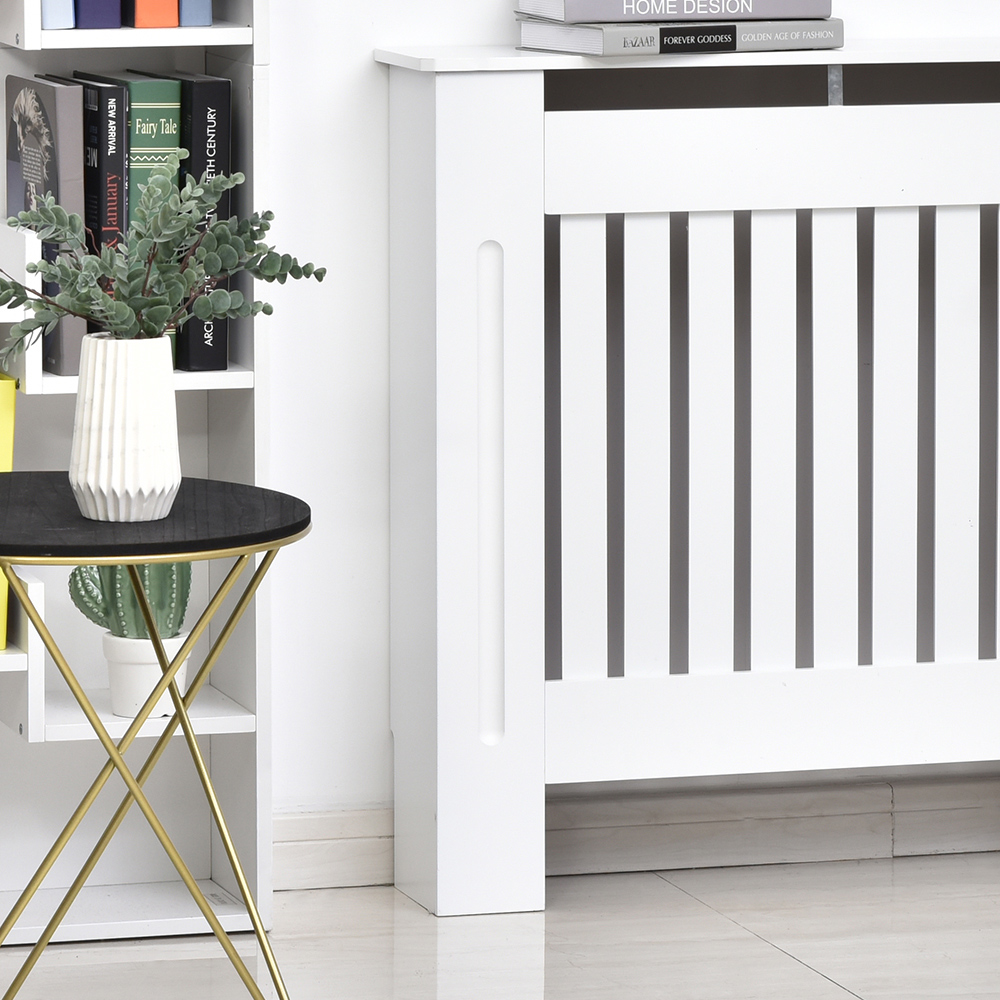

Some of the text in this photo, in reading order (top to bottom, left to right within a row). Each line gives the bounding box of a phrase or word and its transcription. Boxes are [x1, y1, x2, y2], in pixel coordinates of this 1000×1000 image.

[663, 33, 732, 45] FOREVER GODDESS
[741, 30, 834, 42] GOLDEN AGE OF FASHION
[107, 98, 116, 156] NEW ARRIVAL
[135, 118, 158, 139] Fairy
[159, 118, 177, 134] Tale
[206, 107, 216, 158] CENTURY
[102, 172, 121, 233] January
